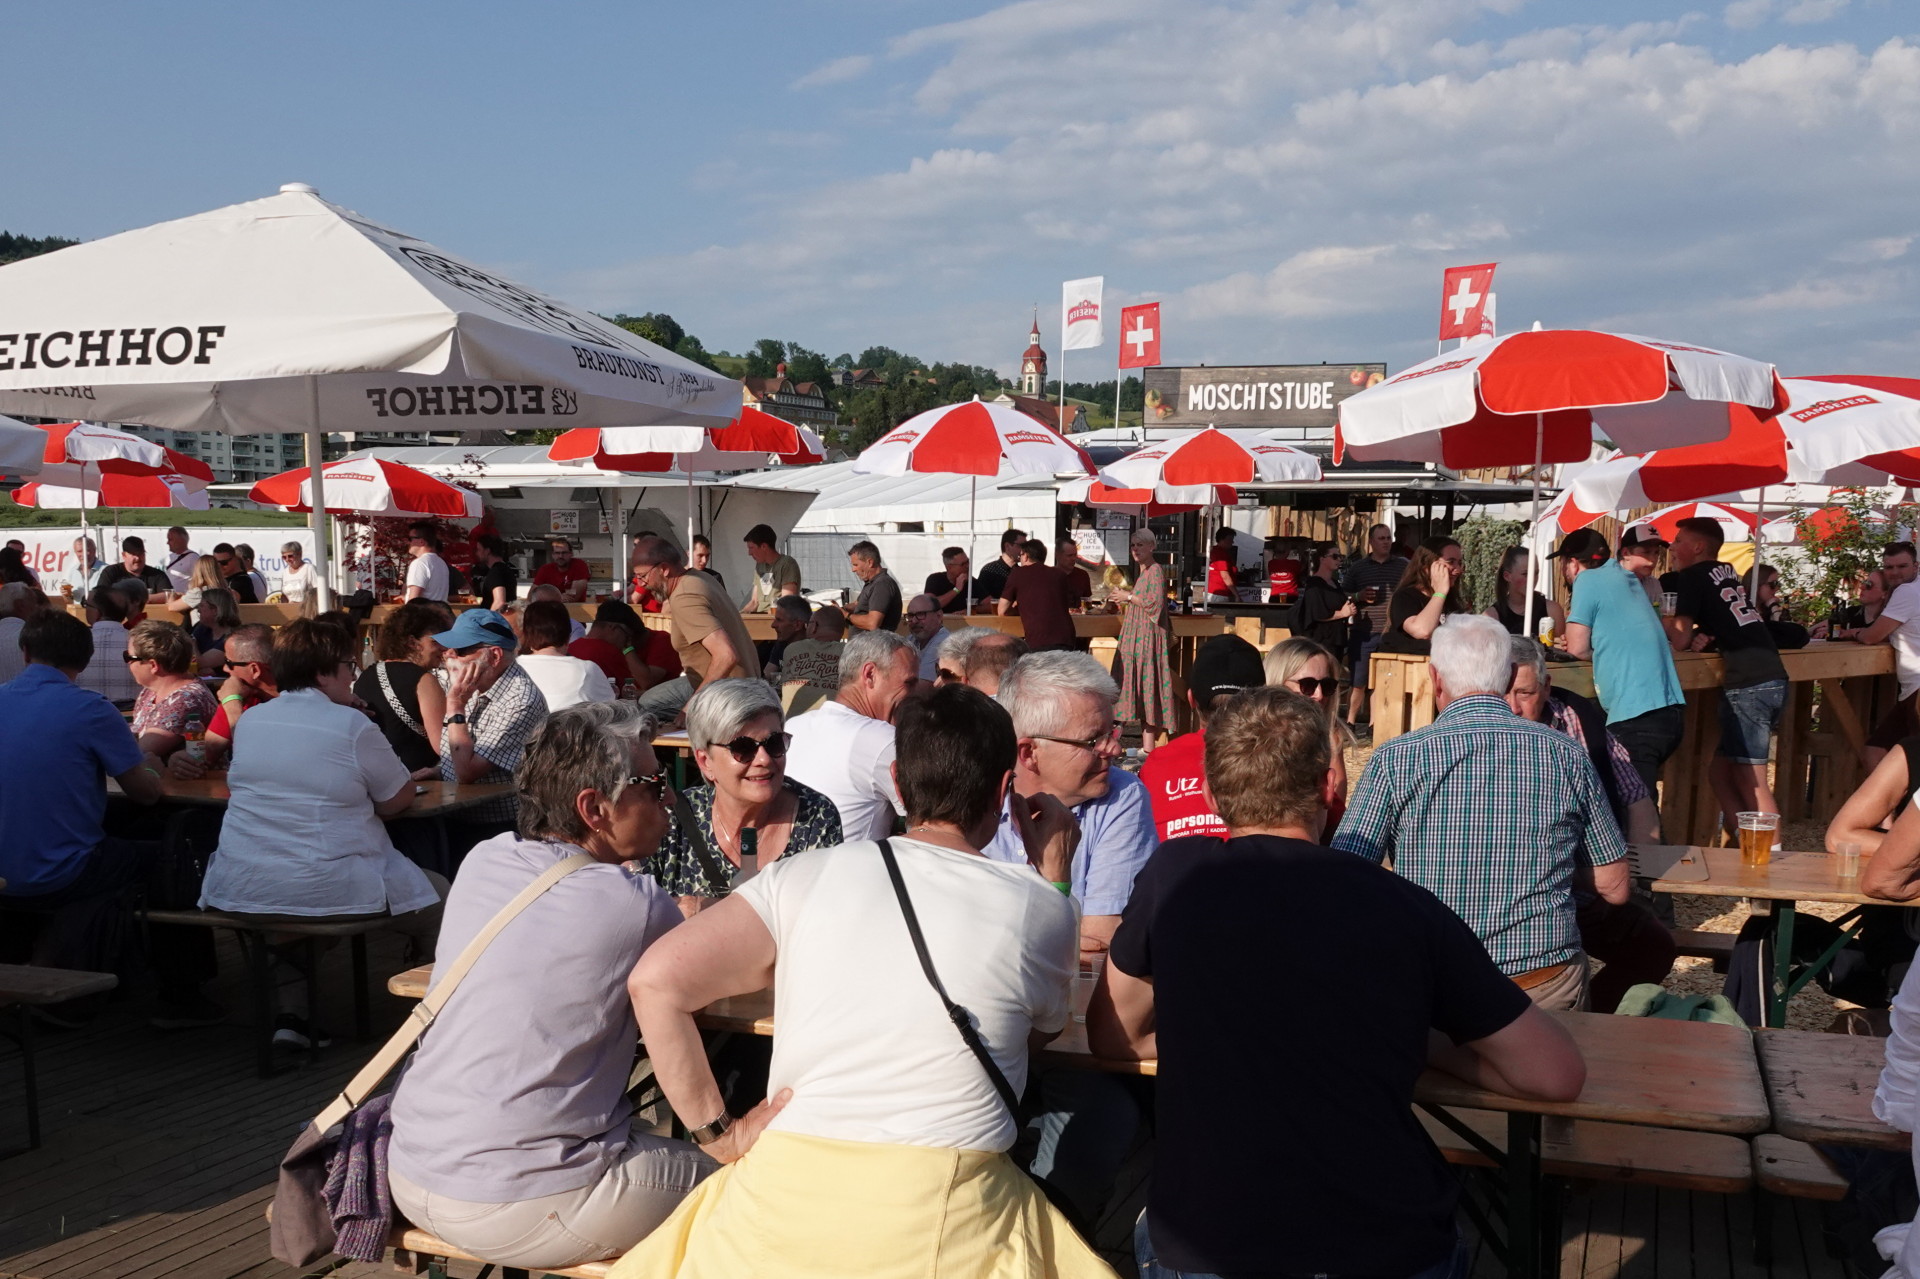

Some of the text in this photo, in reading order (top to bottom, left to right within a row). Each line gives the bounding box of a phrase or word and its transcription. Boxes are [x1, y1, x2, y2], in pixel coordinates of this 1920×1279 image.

[0, 325, 226, 371] EICHHOF
[571, 346, 665, 385] BRAUKUNST
[1188, 381, 1334, 411] MOSCHTSTUBE
[1796, 397, 1870, 419] RAMSEIER
[1008, 434, 1051, 443] RAMSEIER
[1708, 564, 1738, 586] JORDA
[1165, 777, 1199, 795] Utz
